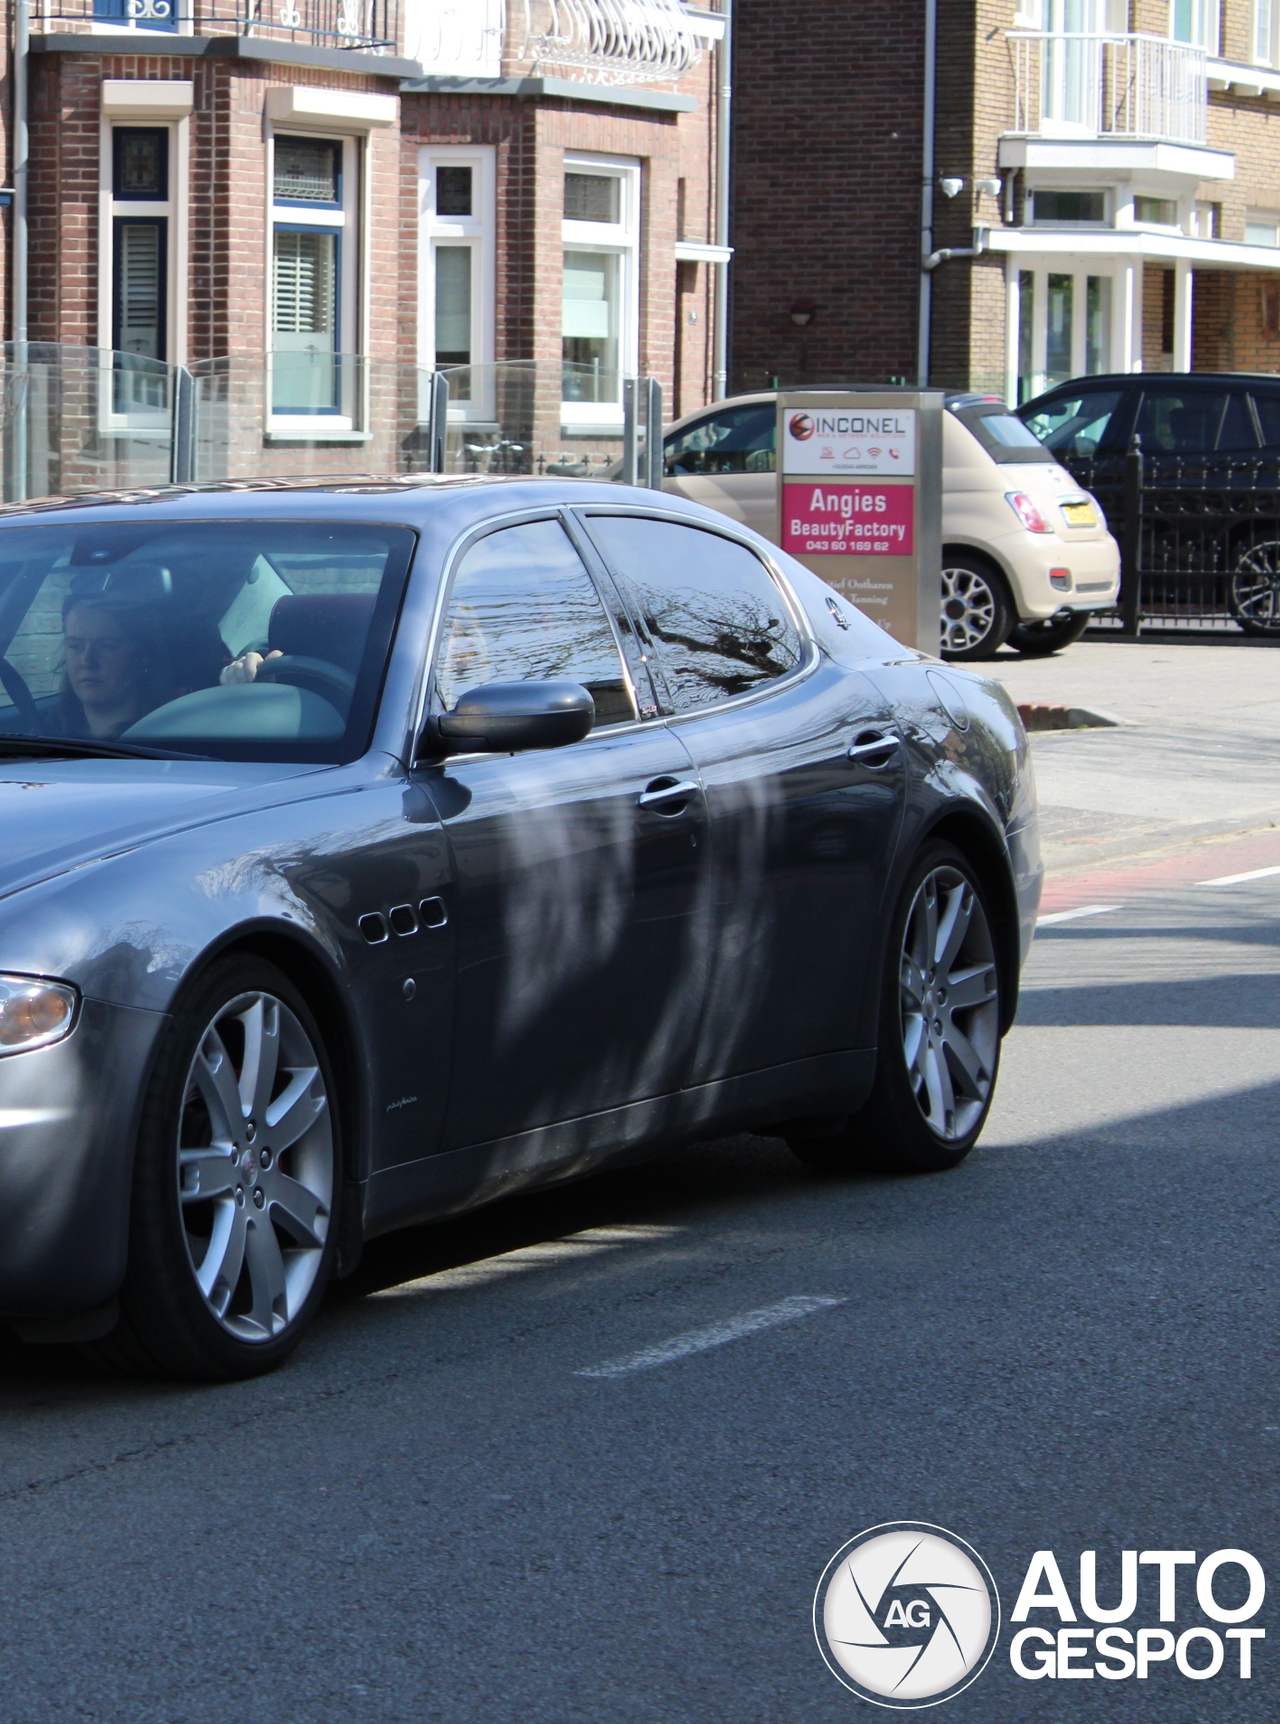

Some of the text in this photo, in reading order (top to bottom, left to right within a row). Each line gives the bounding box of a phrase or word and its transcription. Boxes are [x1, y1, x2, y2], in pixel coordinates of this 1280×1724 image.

[816, 418, 906, 433] INCONEL
[810, 488, 887, 518] Angies
[791, 519, 906, 541] BeautyFactory
[806, 541, 889, 551] 043 60 169 62
[847, 577, 894, 589] Ontharen
[849, 593, 889, 606] Tanning
